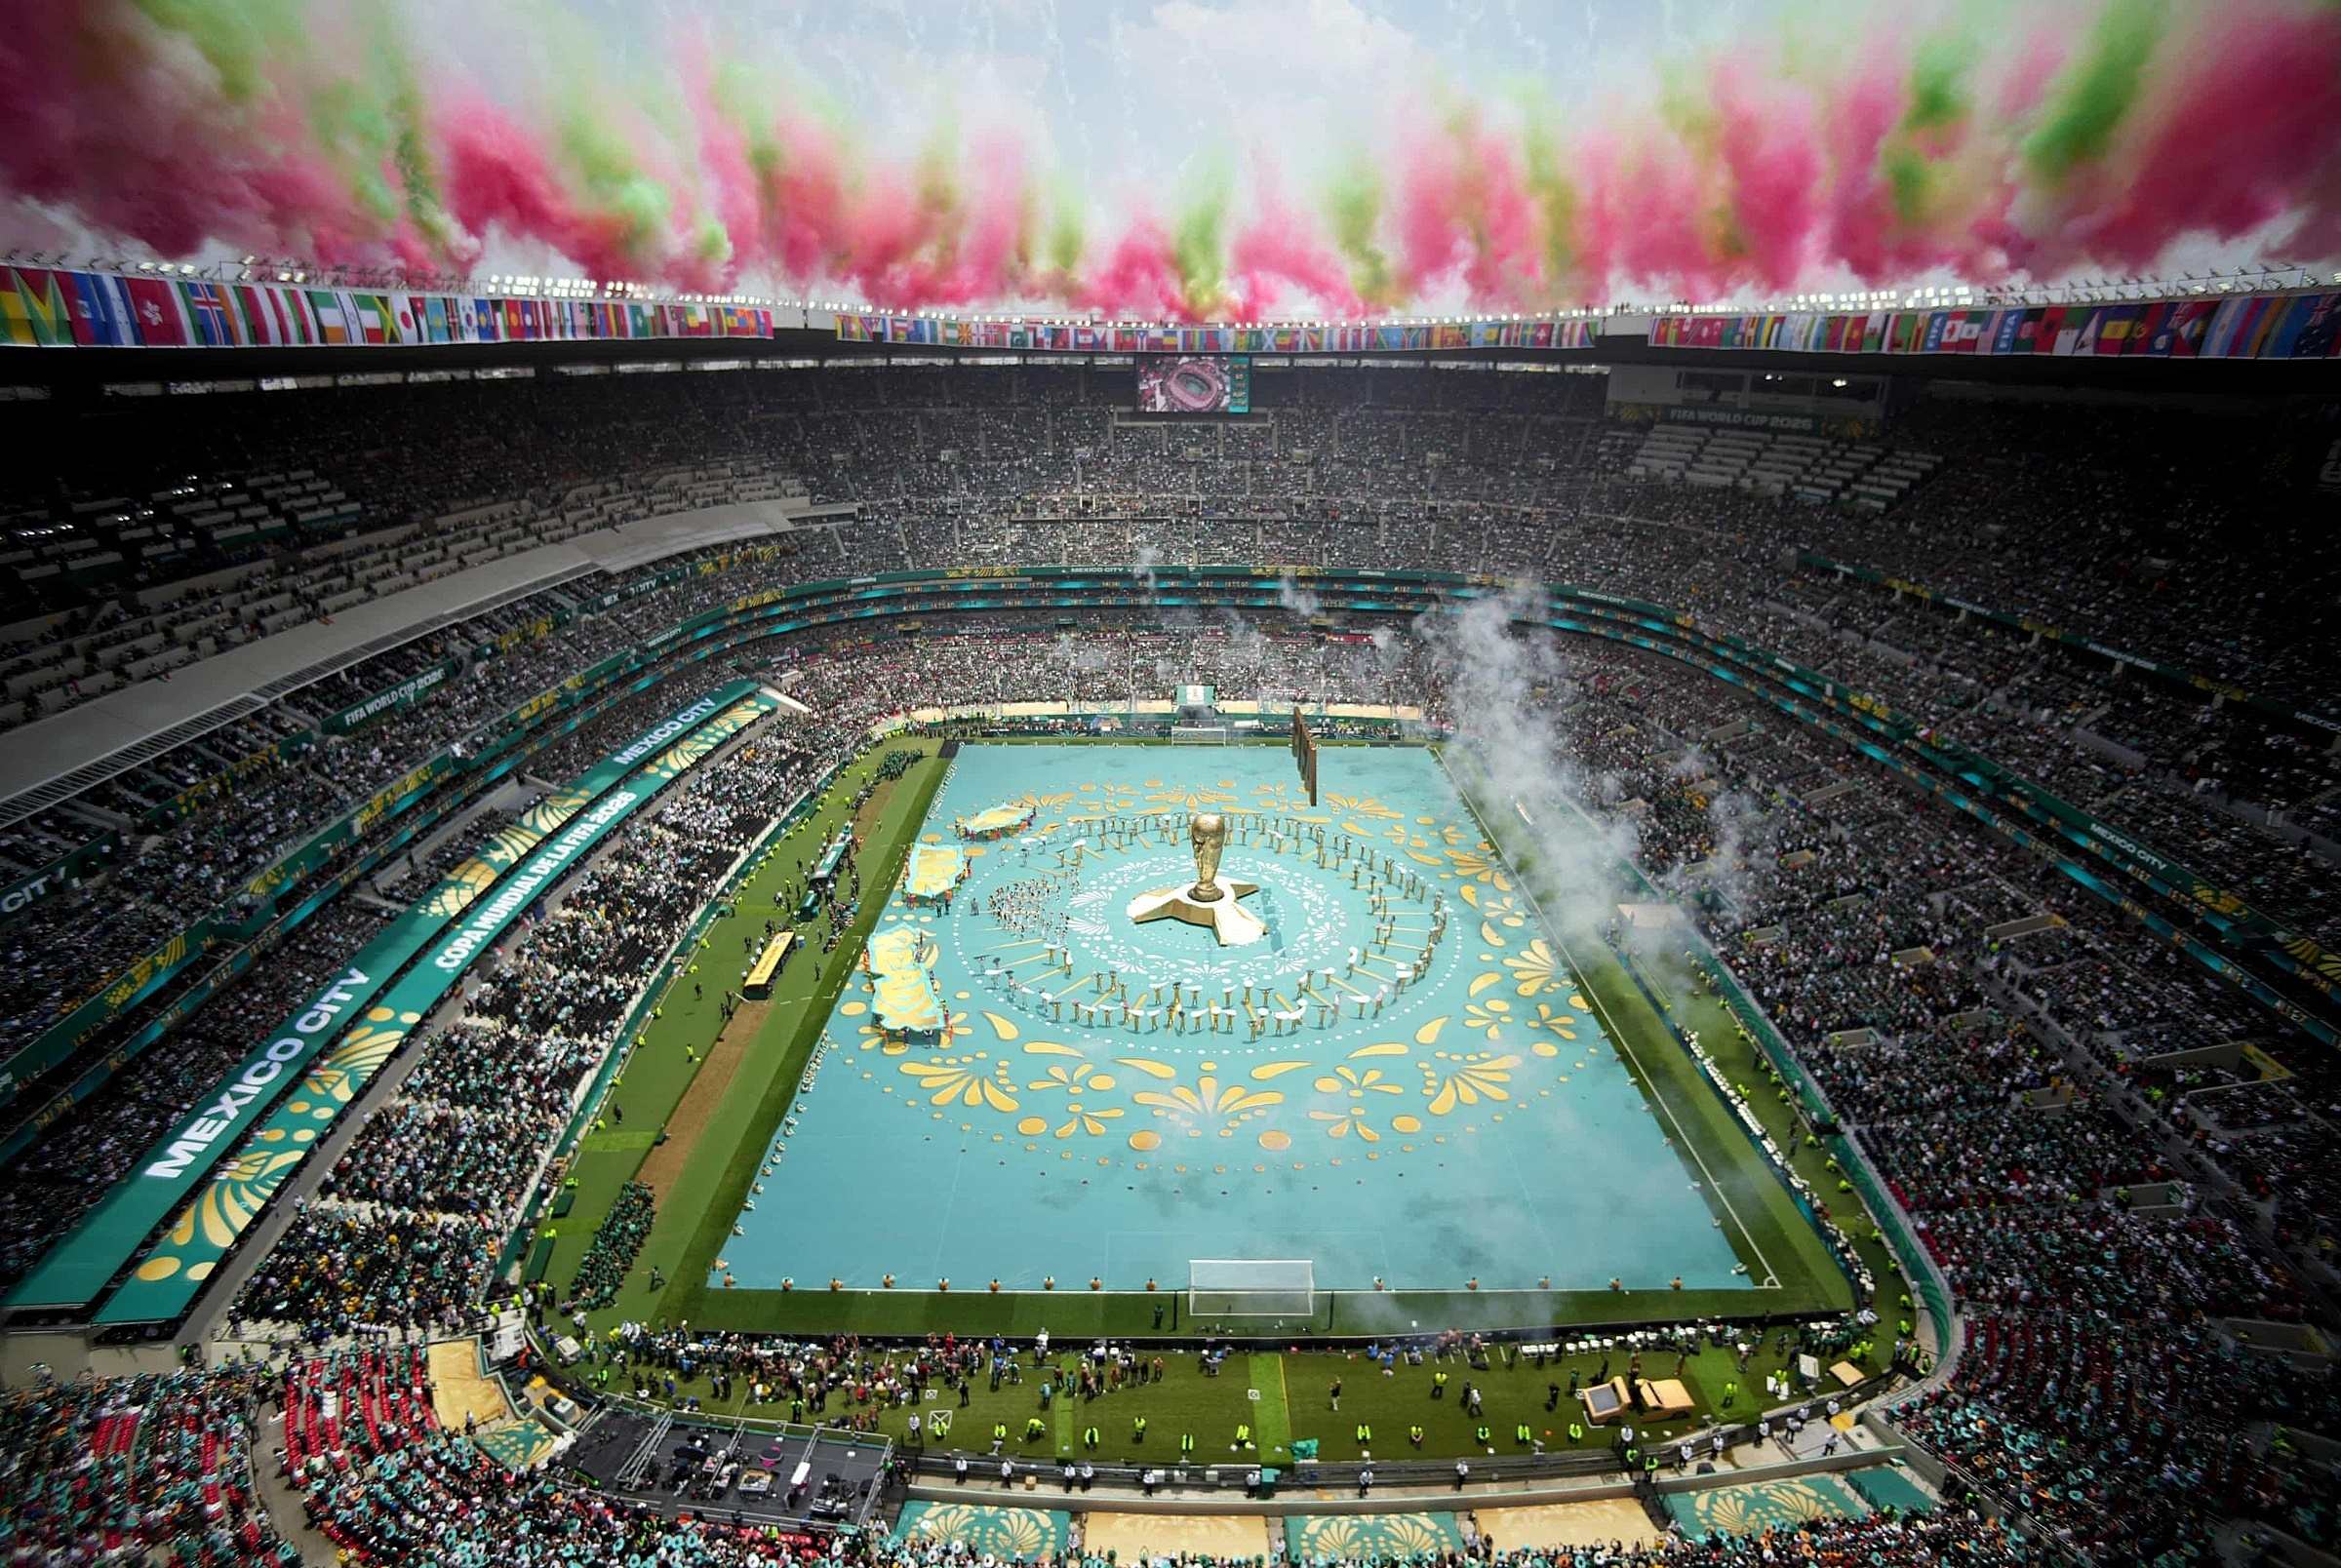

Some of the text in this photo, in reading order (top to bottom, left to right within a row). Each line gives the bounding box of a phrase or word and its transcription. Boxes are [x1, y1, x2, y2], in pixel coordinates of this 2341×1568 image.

[1670, 409, 1812, 430] FIFA WORLD CUP 2026
[344, 707, 367, 725] FIFA
[365, 690, 399, 716] WORLD
[398, 683, 416, 698] CUP
[613, 697, 716, 764] MEXICO CITY
[2090, 823, 2167, 871] MEXICO CITY
[435, 791, 637, 968] COPA MUNDIAL DE LA FIFA 2026
[144, 967, 370, 1179] MEXICO CITY
